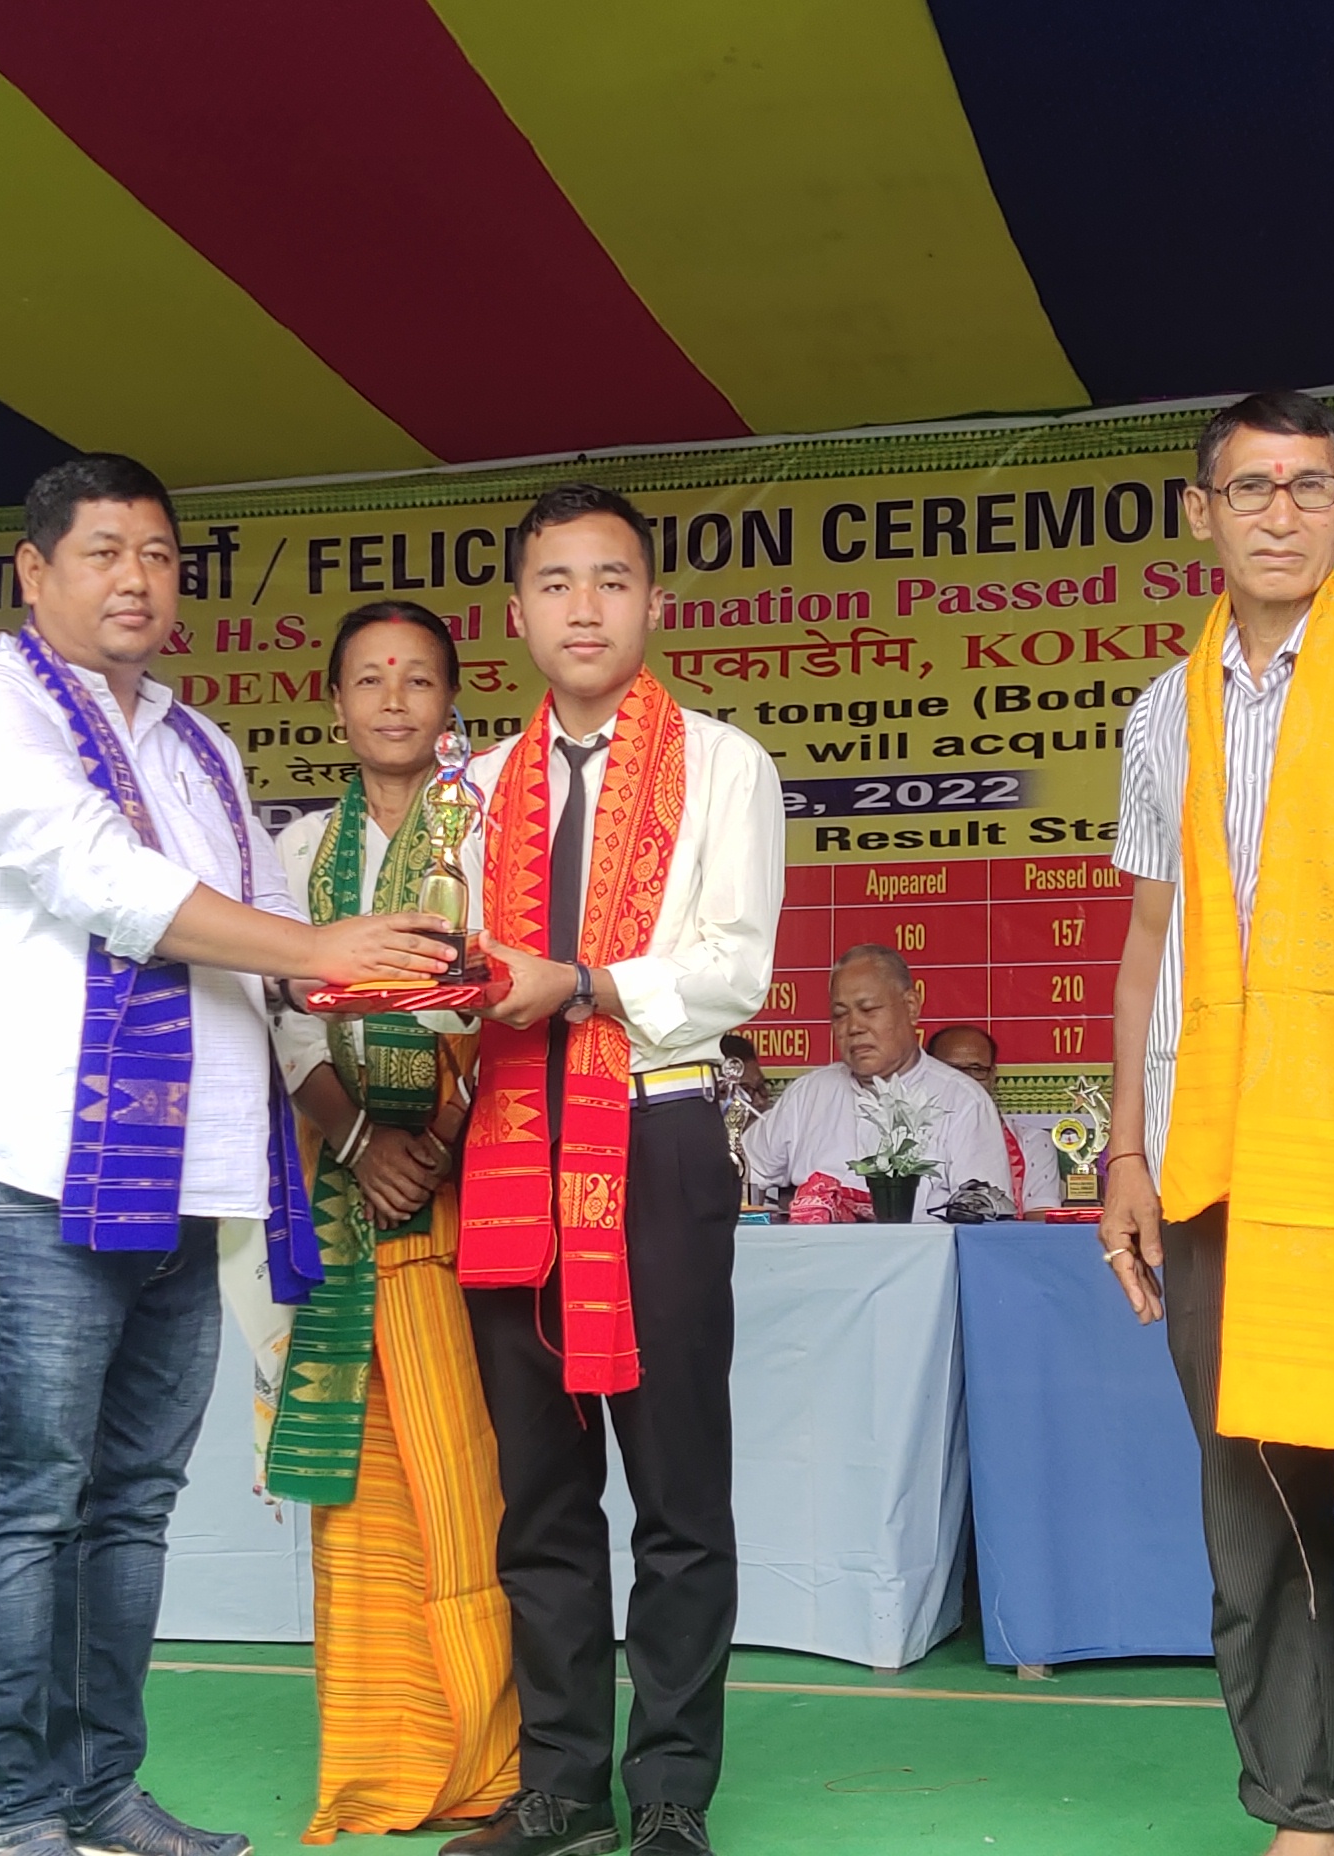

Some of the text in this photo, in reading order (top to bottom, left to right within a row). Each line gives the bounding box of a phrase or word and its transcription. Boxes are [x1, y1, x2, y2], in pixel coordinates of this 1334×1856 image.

[821, 477, 1187, 564] CEREMO
[216, 615, 322, 653] H.S.
[897, 565, 1117, 616] Passed
[756, 695, 950, 727] tongue
[973, 681, 1149, 720] (Bodo
[806, 732, 909, 763] will
[932, 722, 1124, 760] acqui
[853, 775, 1020, 810] 2022
[815, 816, 1119, 853] Result Sta
[866, 866, 947, 901] Appeared
[1025, 862, 1122, 891] Passed out
[895, 923, 926, 951] 160
[1051, 918, 1084, 947] 157
[1051, 975, 1084, 1003] 210
[1051, 1026, 1084, 1054] 117
